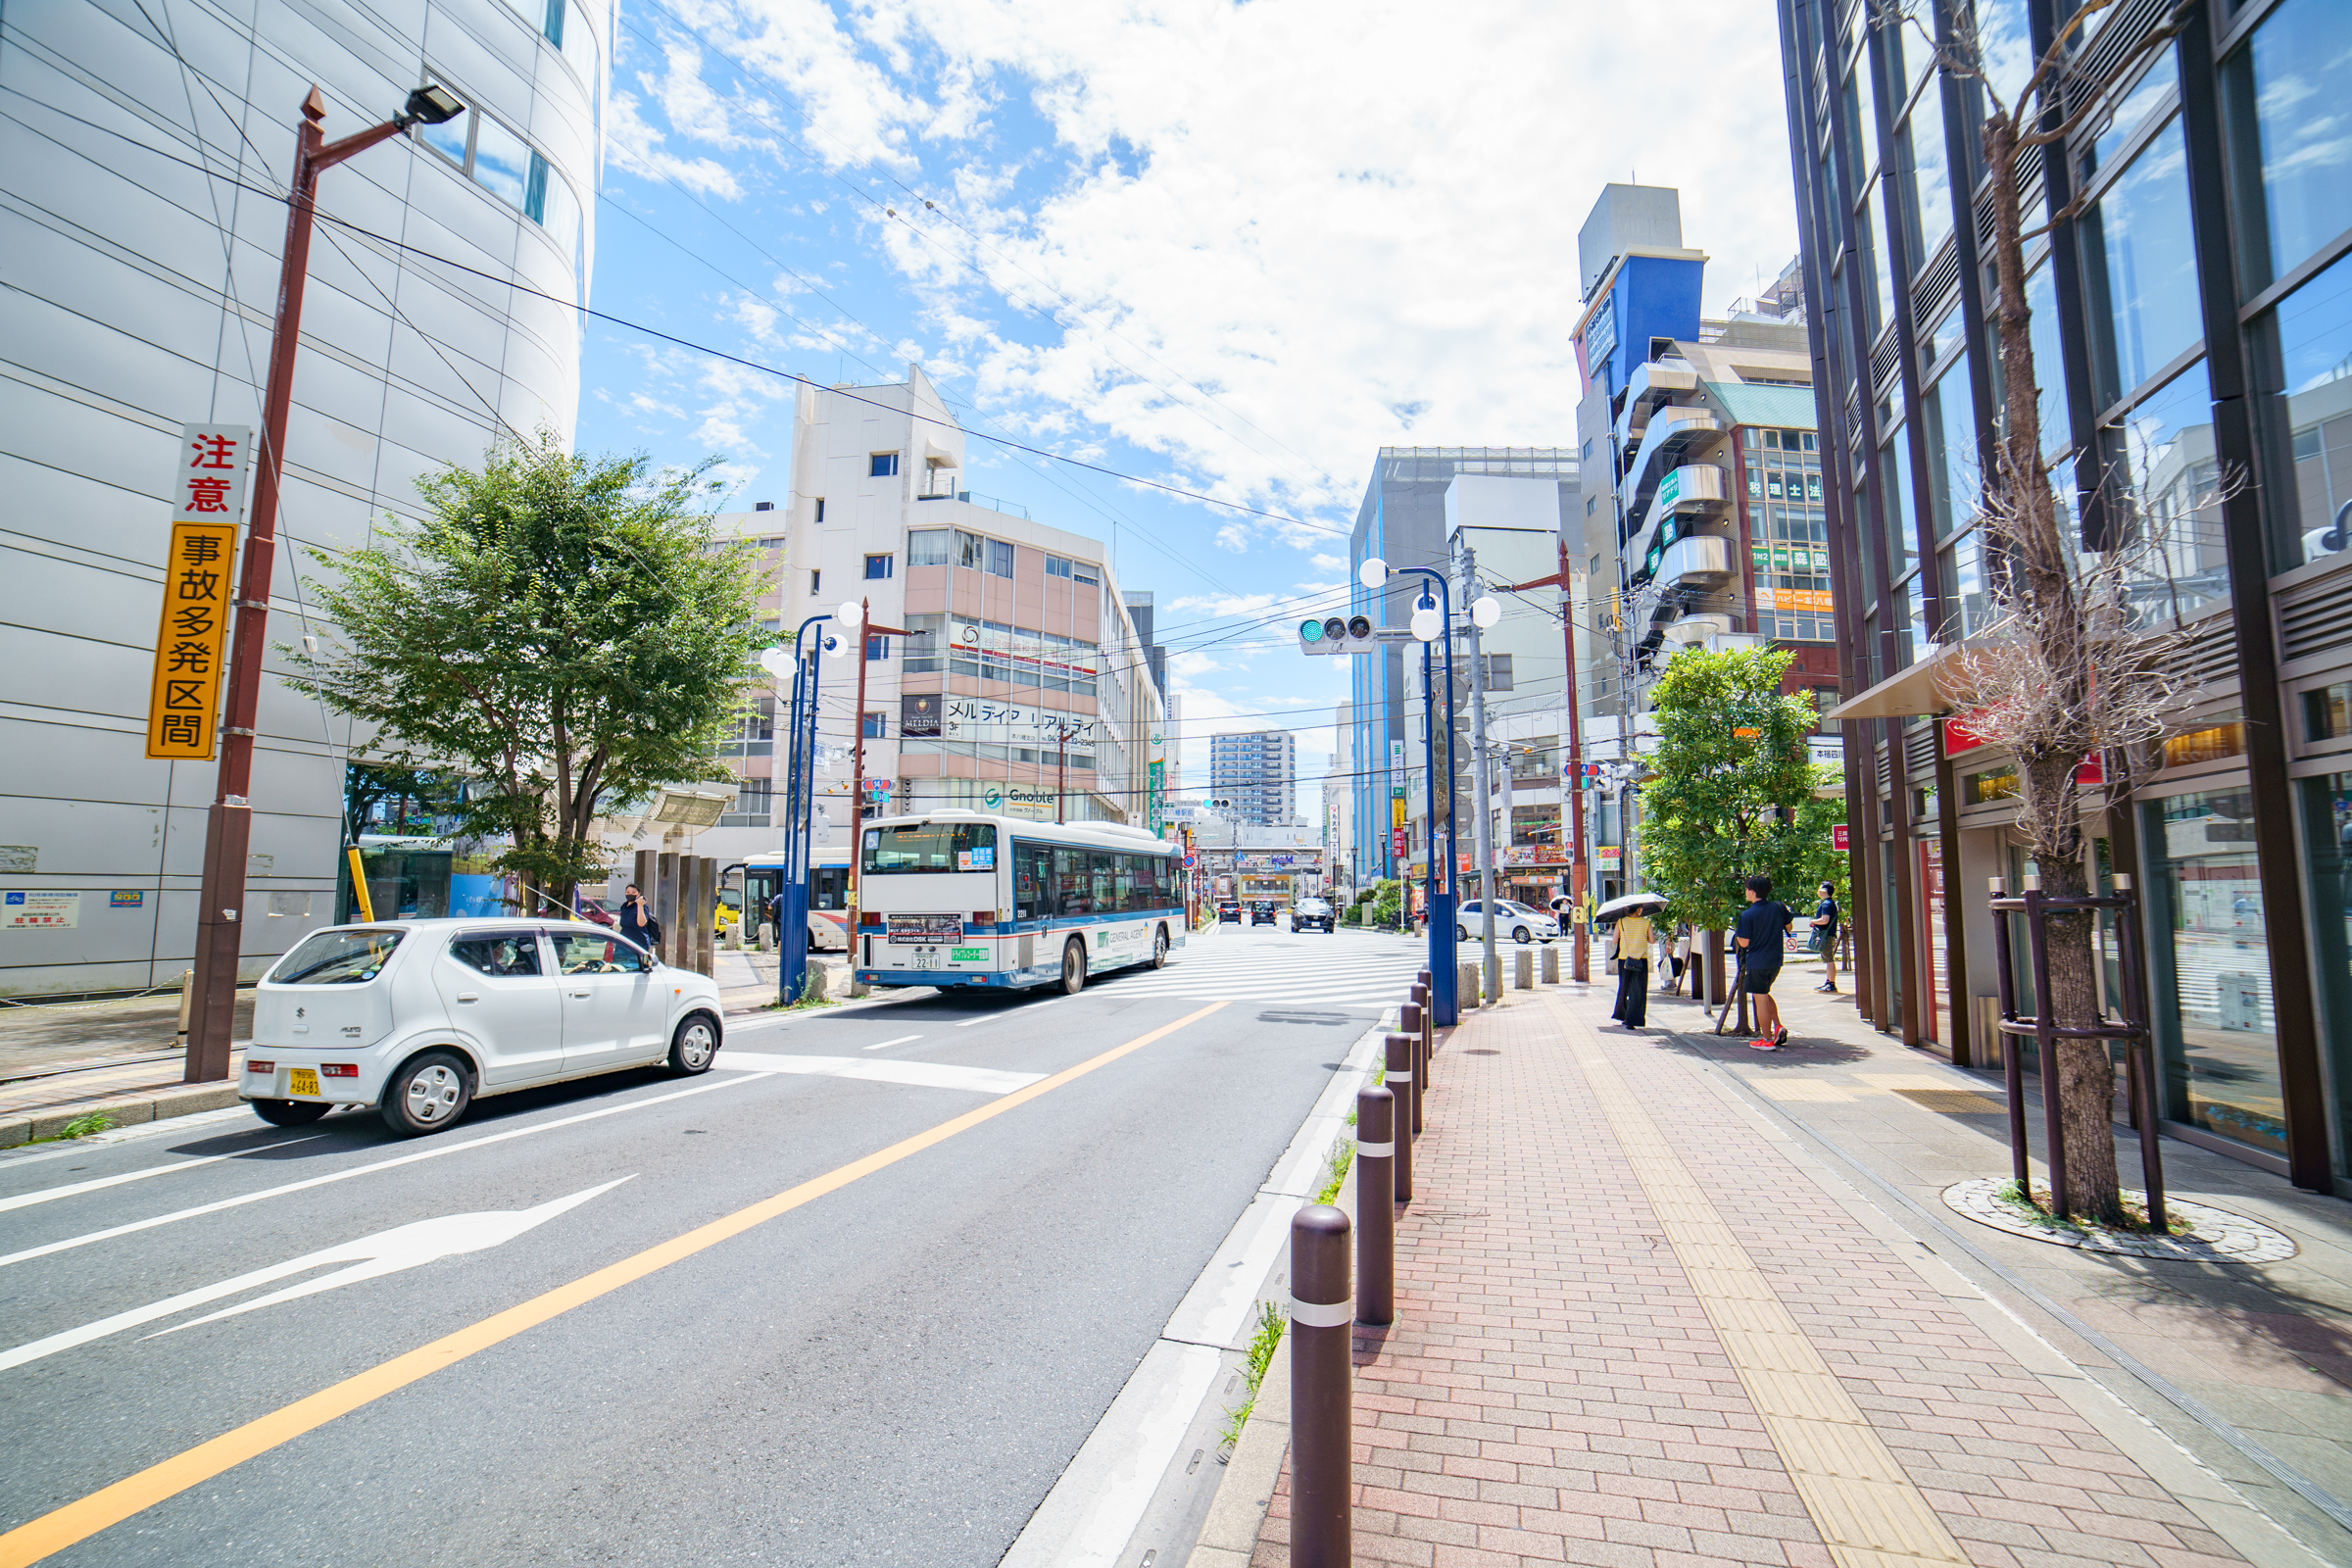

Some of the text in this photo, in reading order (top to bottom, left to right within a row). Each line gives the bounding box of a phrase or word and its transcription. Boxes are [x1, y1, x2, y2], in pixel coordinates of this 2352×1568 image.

[184, 433, 237, 513] 注意
[1749, 480, 1821, 498] 税理士法
[1793, 552, 1828, 566] 森塾
[161, 534, 222, 748] 事故多発区間
[905, 718, 940, 727] MELDIA
[949, 720, 959, 731] 3F
[1434, 728, 1448, 808] 八幡中央通り
[1009, 789, 1054, 804] Gnoble
[1162, 808, 1194, 817] 本八幡駅前
[1017, 909, 1027, 918] 2211
[1109, 929, 1144, 943] GENERAL AGENT
